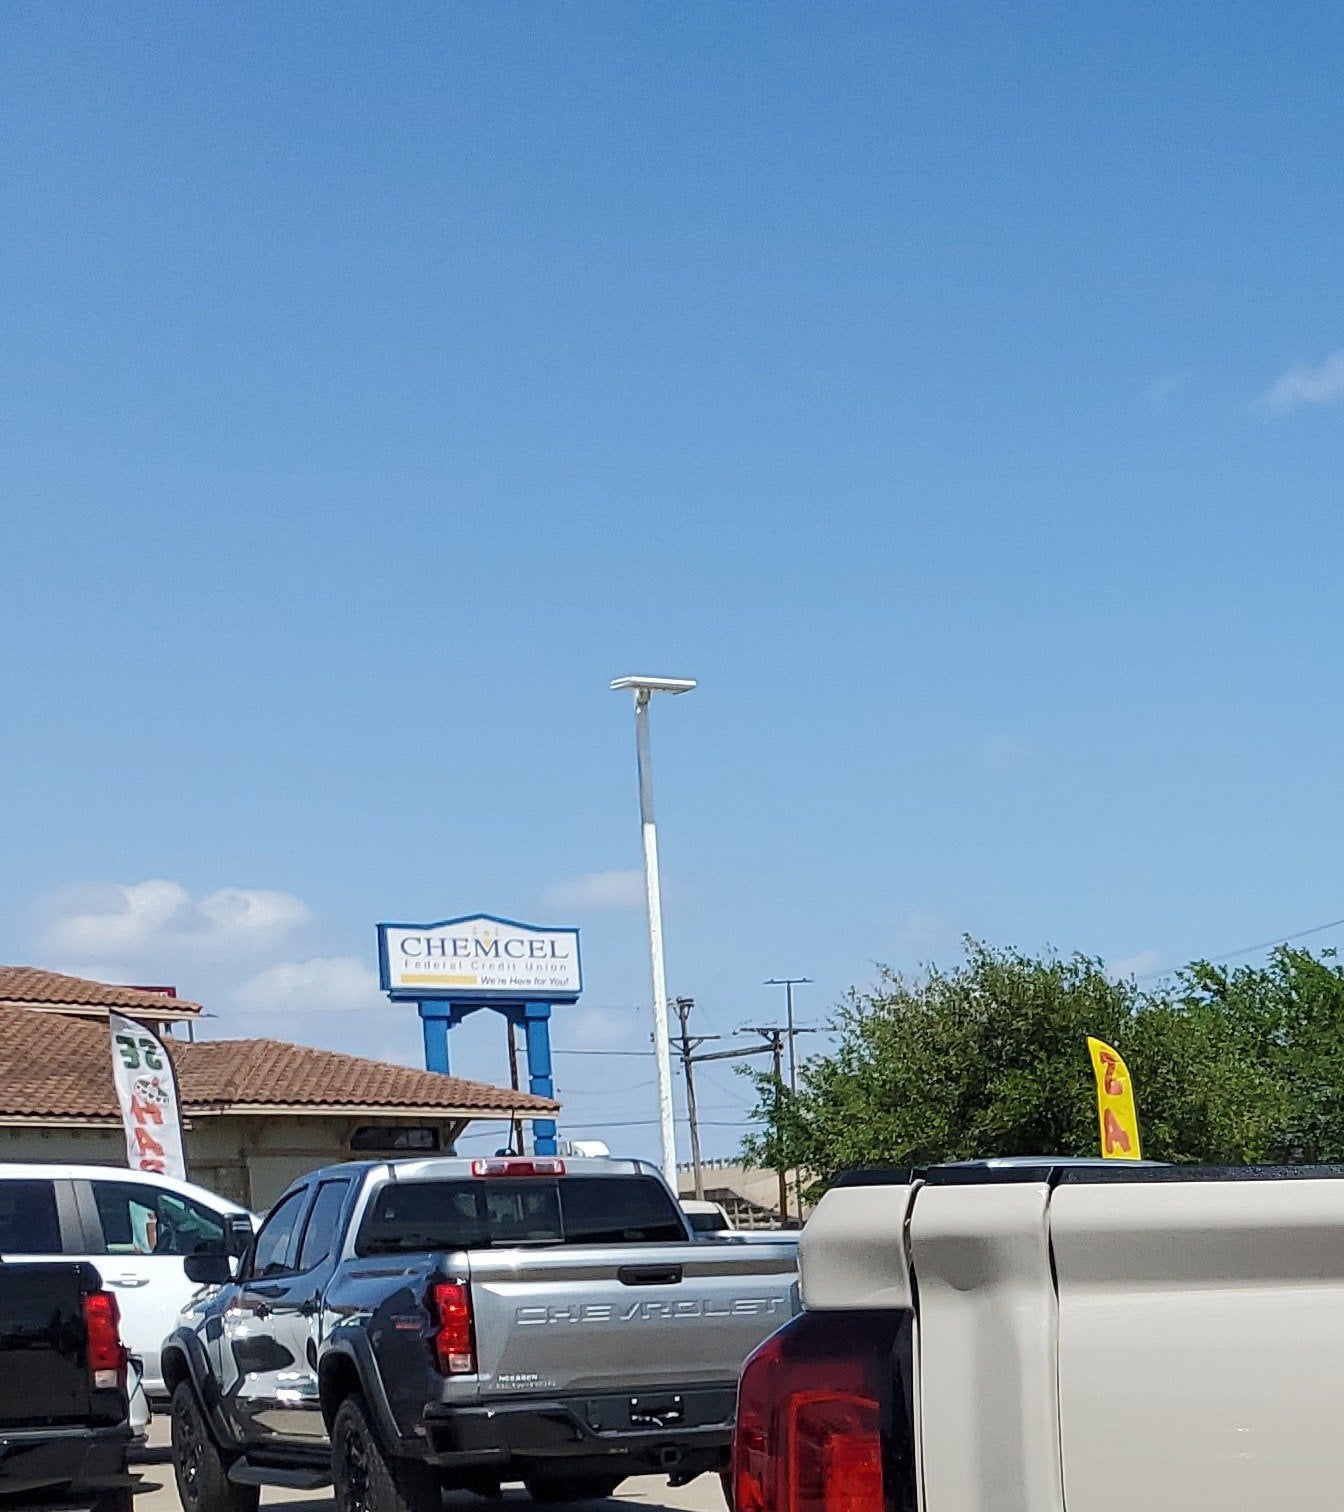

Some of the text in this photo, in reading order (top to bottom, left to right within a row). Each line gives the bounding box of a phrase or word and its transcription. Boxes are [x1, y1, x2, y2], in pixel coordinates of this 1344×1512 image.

[400, 936, 570, 959] CHEMCEL
[404, 959, 568, 973] Federal Credit Union
[516, 1297, 784, 1325] CHEVROLET
